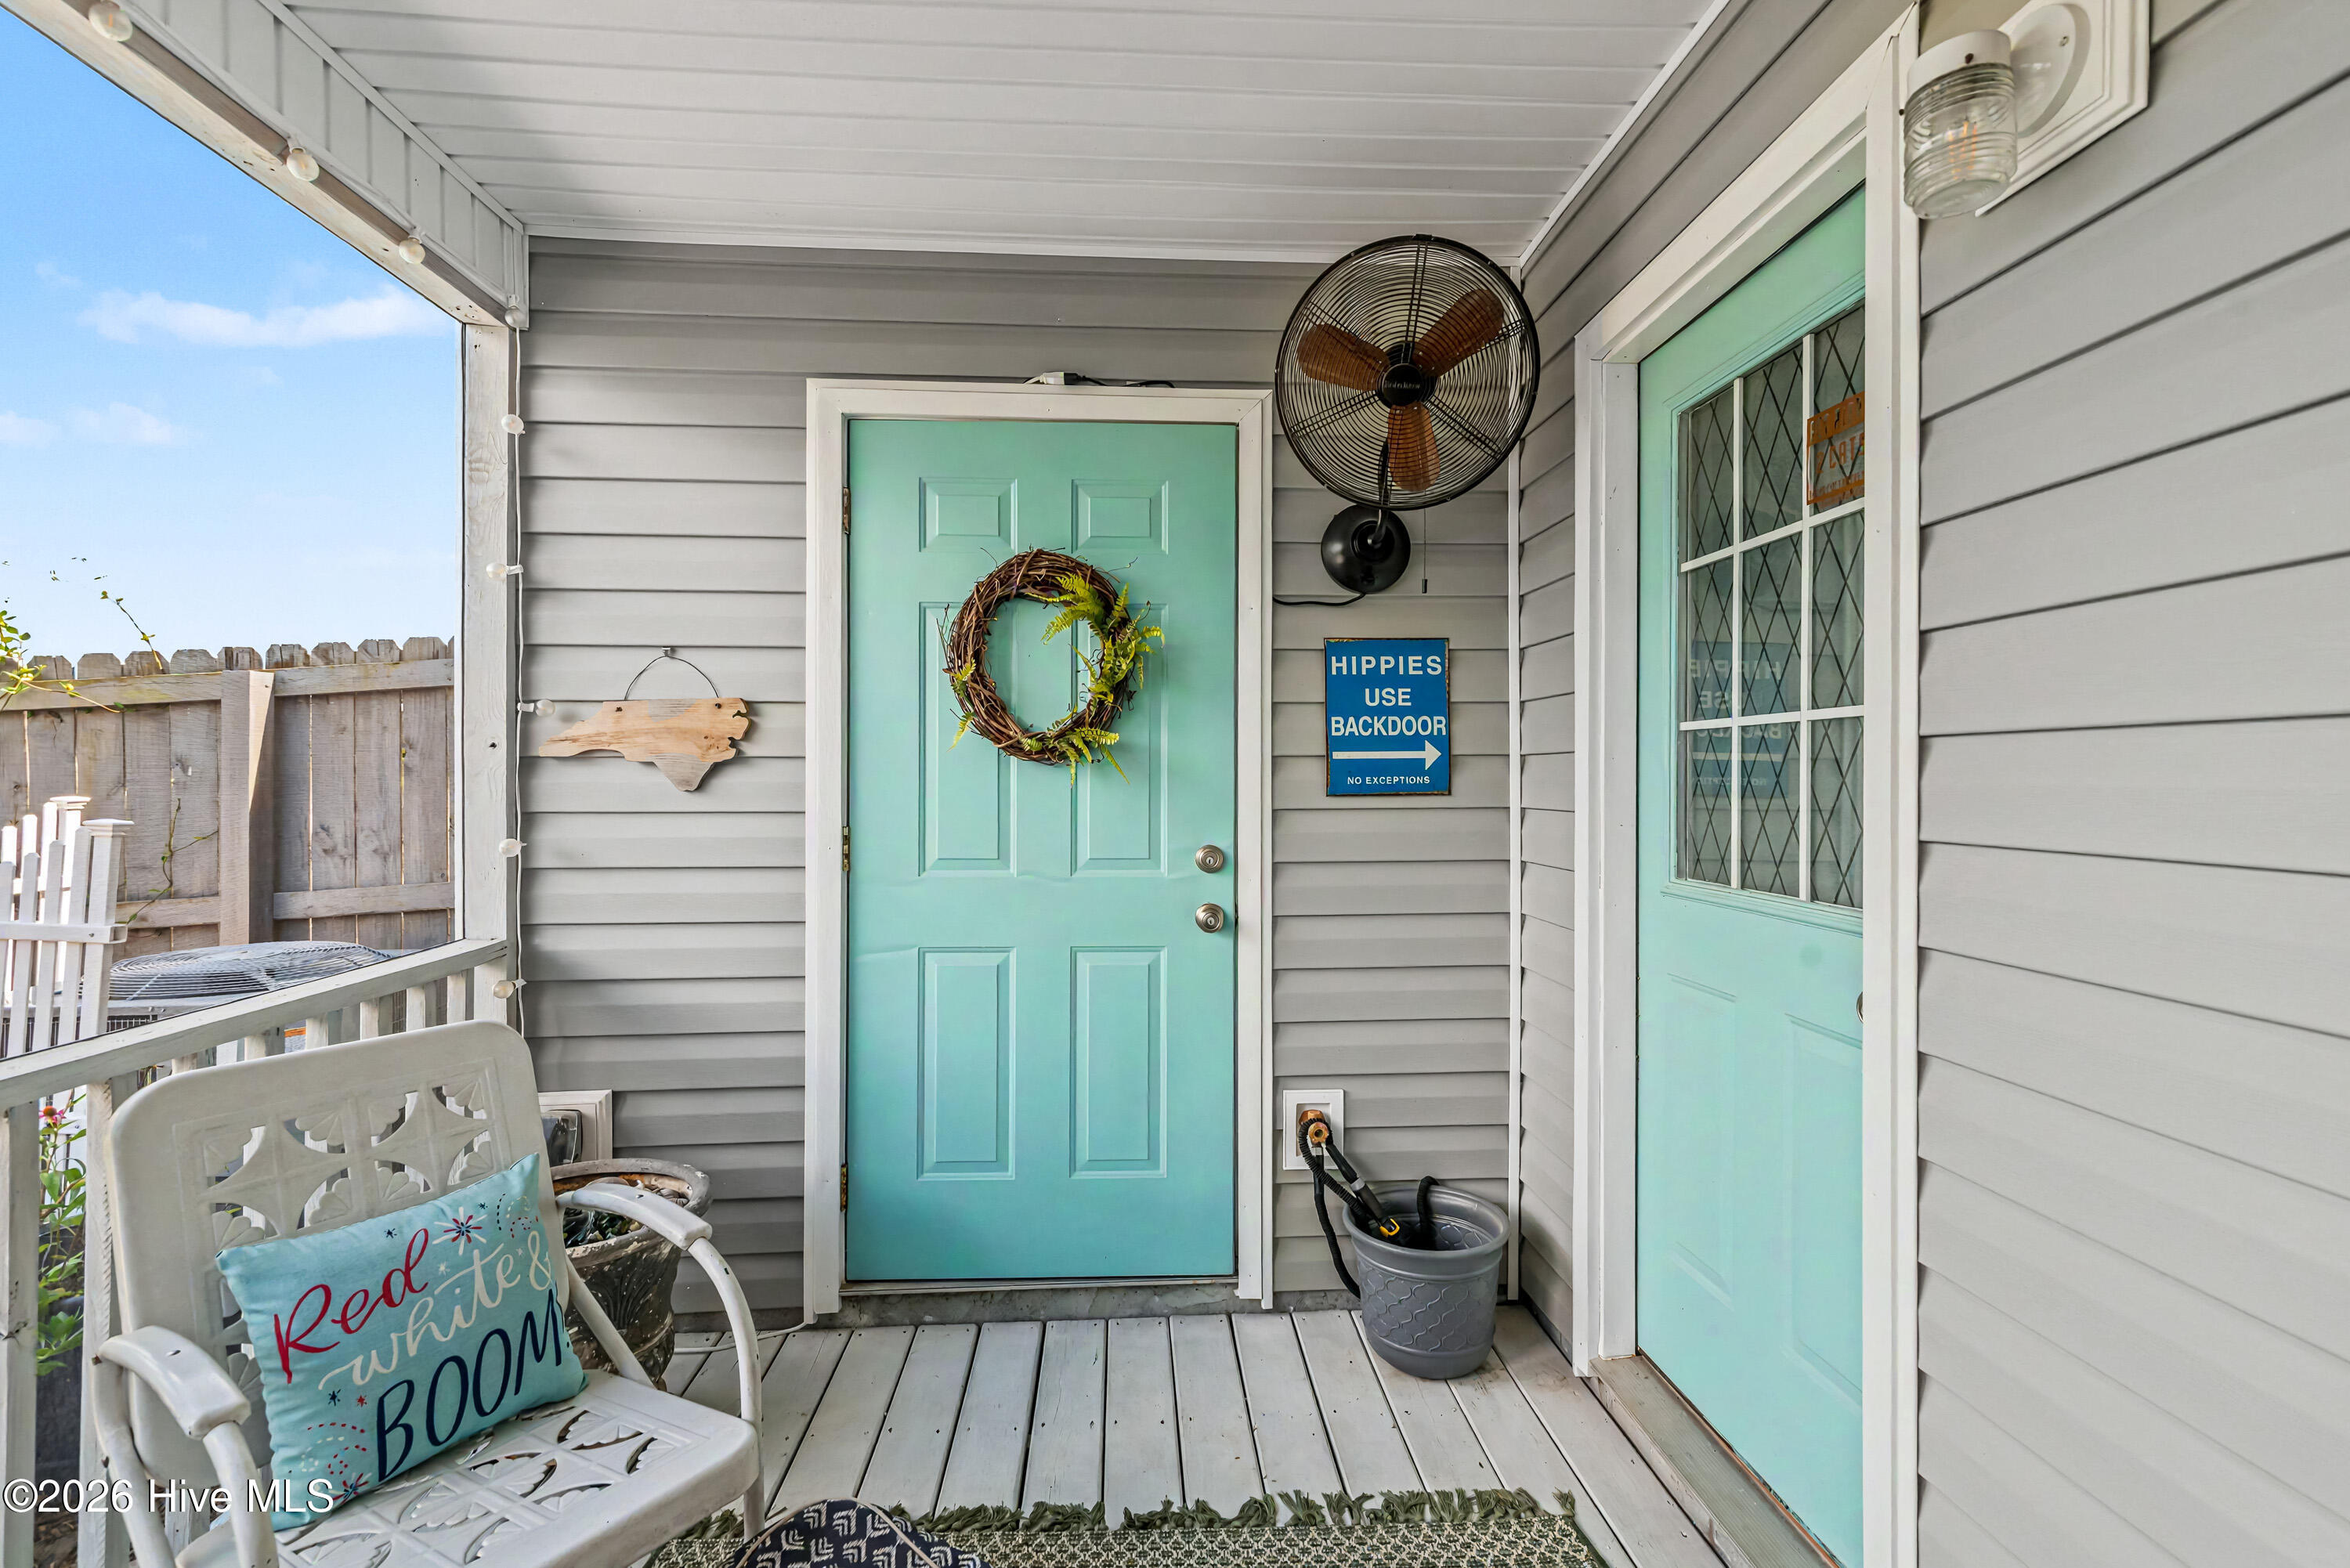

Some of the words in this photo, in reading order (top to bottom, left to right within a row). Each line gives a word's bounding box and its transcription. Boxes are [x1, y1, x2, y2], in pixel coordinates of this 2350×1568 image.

[1331, 656, 1442, 676] HIPPIES
[1365, 688, 1412, 706] USE
[1331, 715, 1447, 736] BACKDOOR
[1347, 776, 1361, 785] NO
[1365, 775, 1430, 785] EXCEPTIONS
[273, 1228, 430, 1385] Red
[318, 1242, 521, 1391] white
[527, 1230, 552, 1292] &
